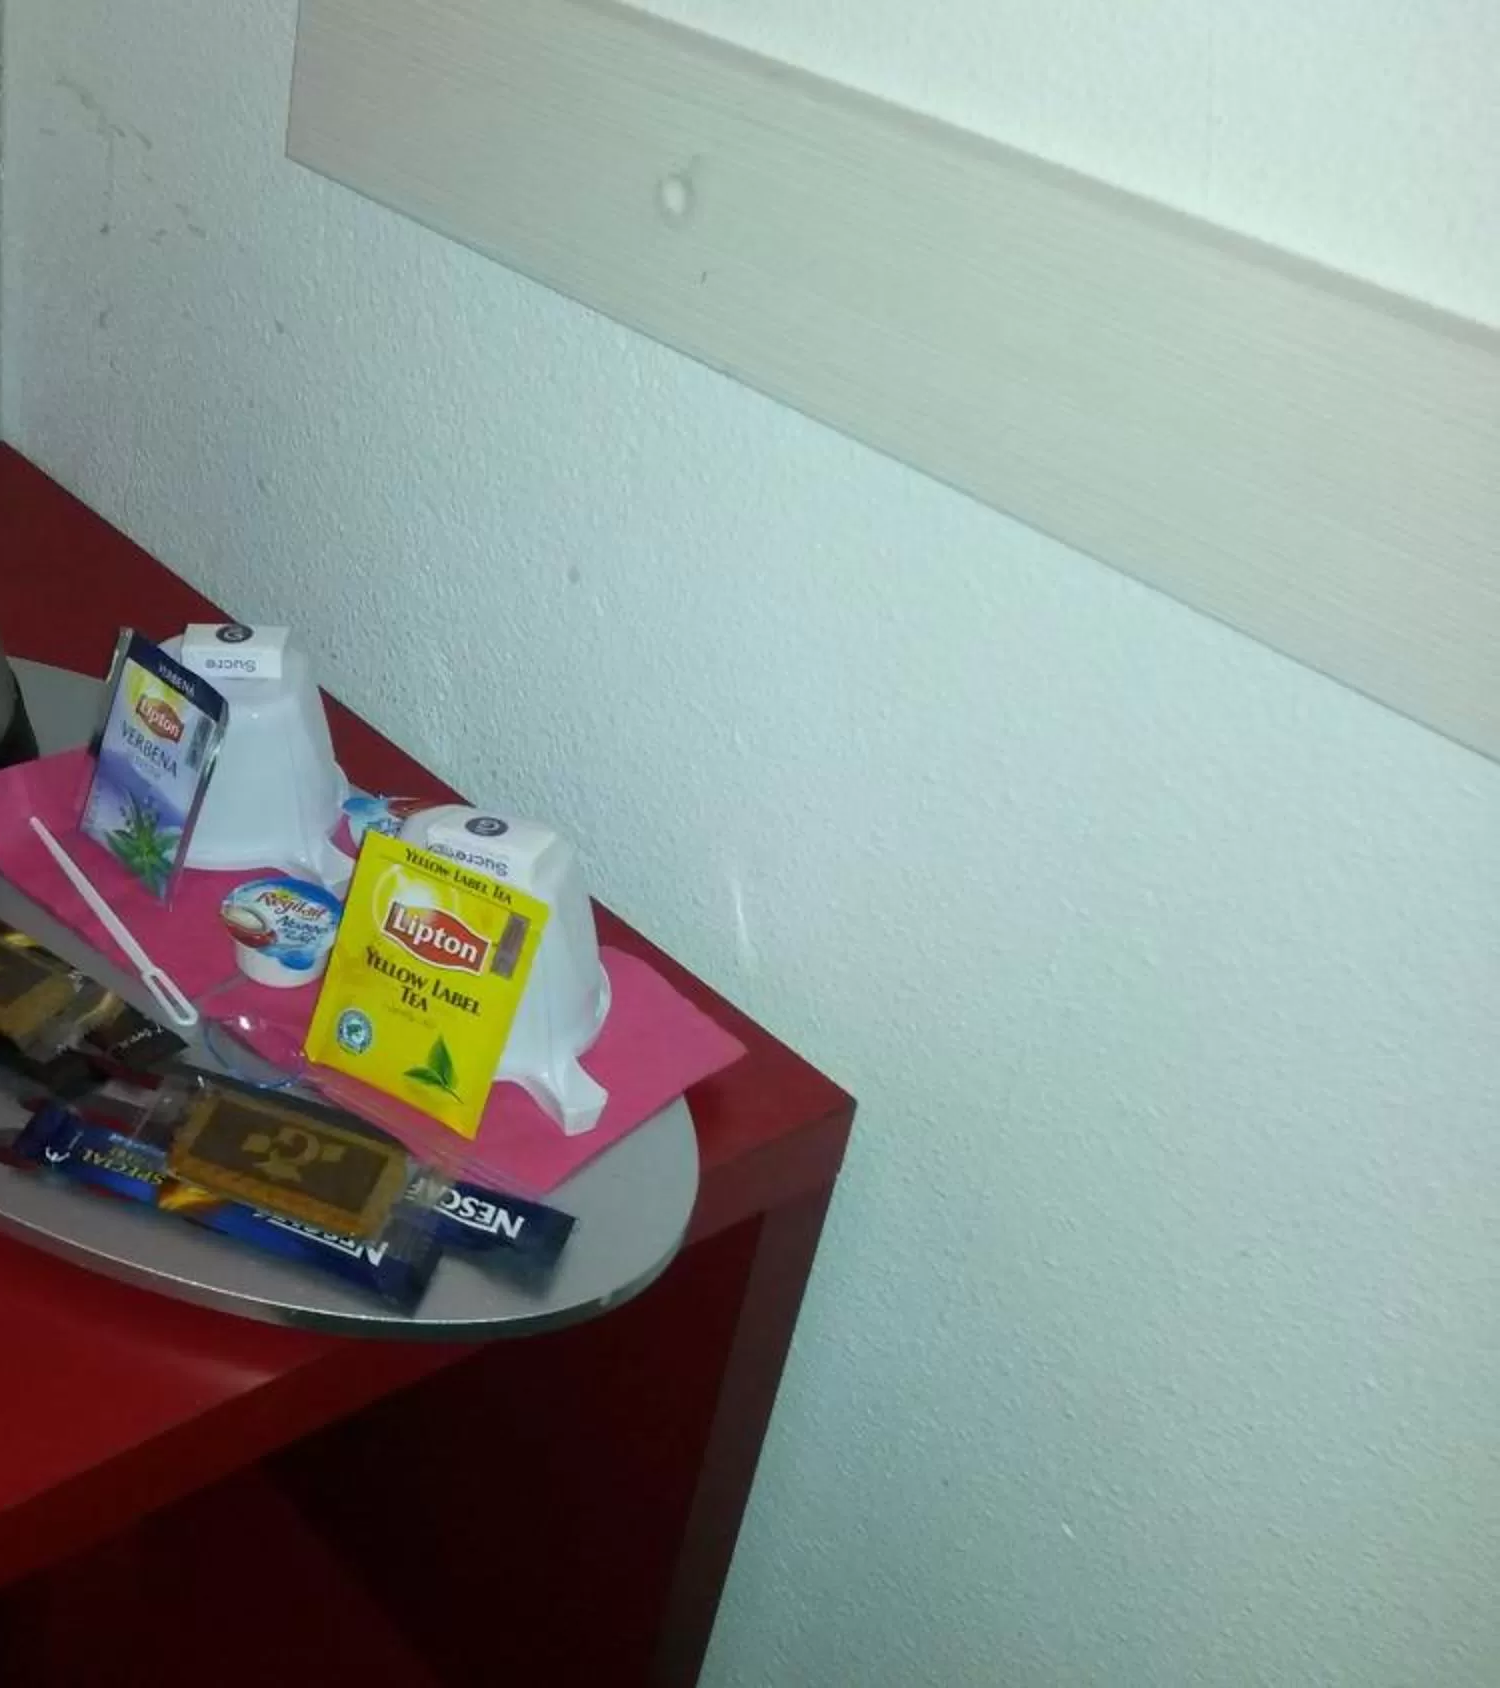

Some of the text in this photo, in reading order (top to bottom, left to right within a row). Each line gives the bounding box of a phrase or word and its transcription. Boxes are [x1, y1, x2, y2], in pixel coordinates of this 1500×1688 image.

[205, 658, 257, 673] Sucre
[139, 698, 181, 740] Lipton
[120, 719, 178, 779] VERBENA
[404, 847, 513, 906] YELLOW LABEL TEA
[392, 905, 479, 964] Lipton
[365, 945, 481, 1015] YELLOW LABEL
[400, 985, 429, 1013] TEA
[403, 1176, 526, 1240] NESCAF
